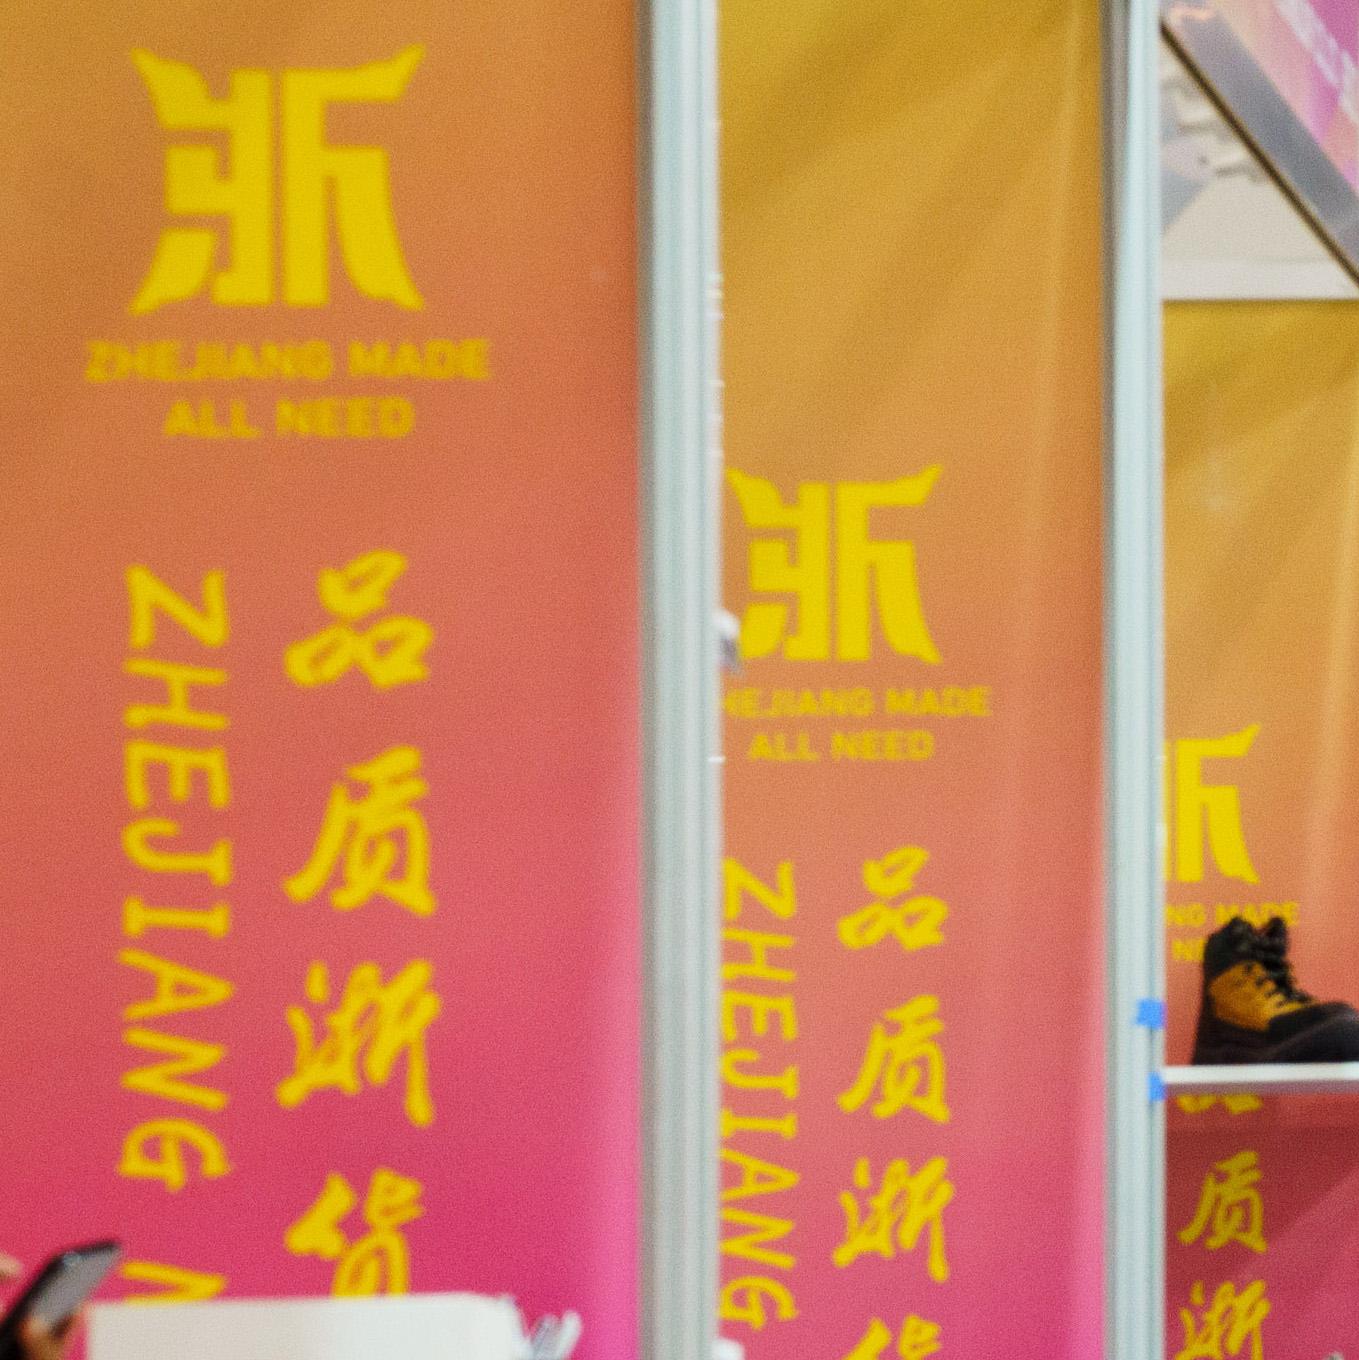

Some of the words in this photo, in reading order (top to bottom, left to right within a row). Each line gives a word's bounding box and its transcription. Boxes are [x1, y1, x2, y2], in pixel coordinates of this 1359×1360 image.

[86, 339, 331, 383] ZHEJIANG
[347, 337, 492, 380] MADE
[163, 399, 261, 438] ALL
[275, 396, 416, 438] NEED
[886, 685, 991, 717] MADE
[749, 730, 820, 762] ALL
[830, 729, 935, 761] NEED
[118, 563, 233, 1192] ZHEJIANG
[719, 857, 800, 1331] ZHEJIANG
